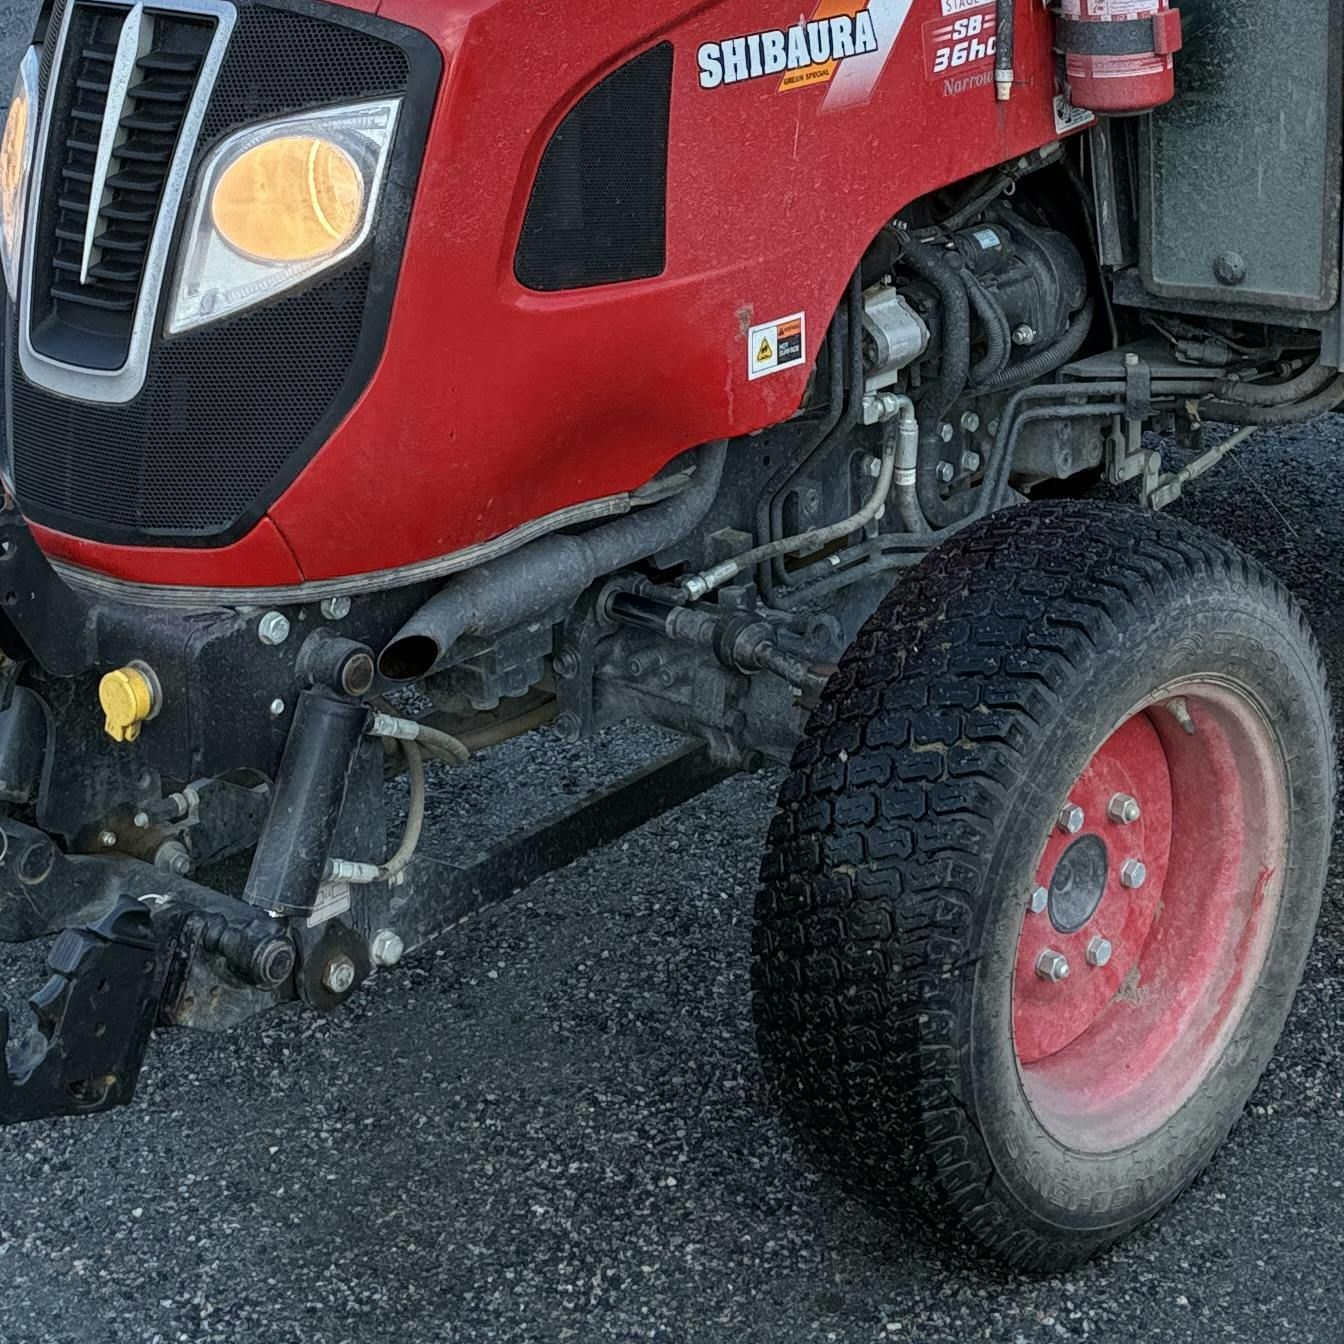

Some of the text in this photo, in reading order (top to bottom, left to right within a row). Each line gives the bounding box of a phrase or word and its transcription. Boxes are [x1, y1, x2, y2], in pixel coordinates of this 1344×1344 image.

[952, 15, 983, 41] SB
[697, 9, 878, 89] SHIBAURA
[783, 69, 830, 86] GREEN SPECIAL
